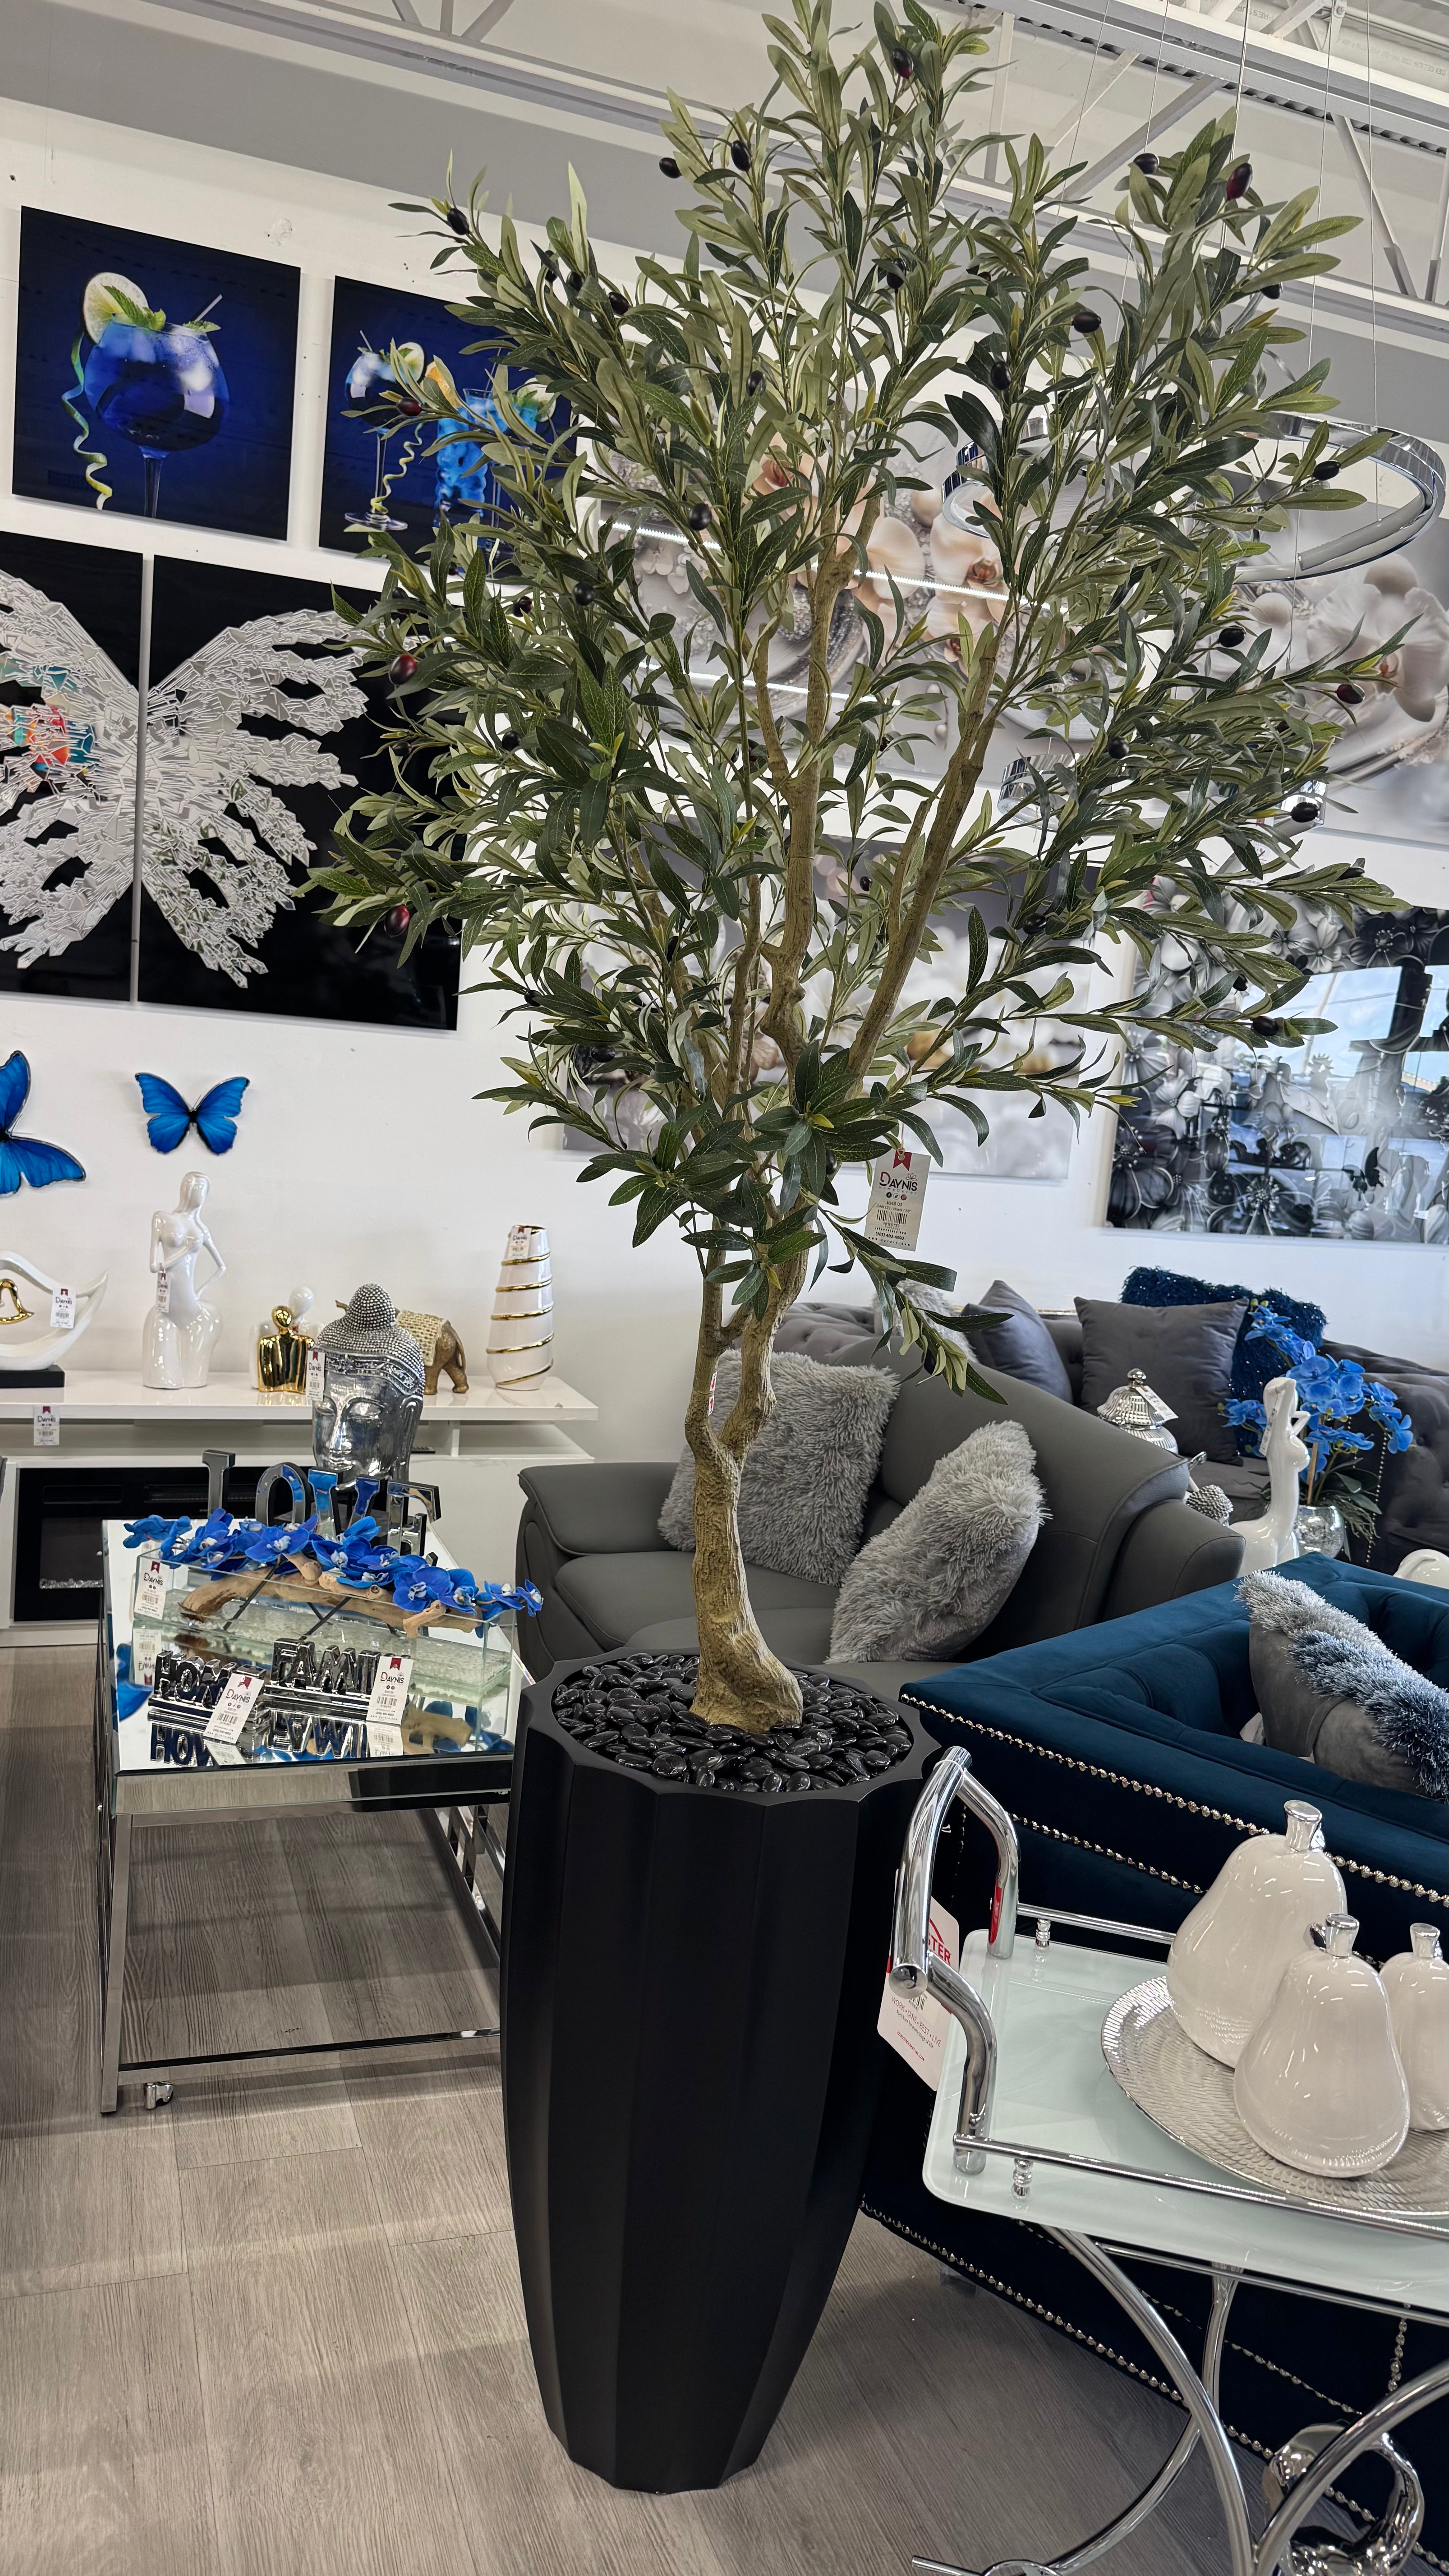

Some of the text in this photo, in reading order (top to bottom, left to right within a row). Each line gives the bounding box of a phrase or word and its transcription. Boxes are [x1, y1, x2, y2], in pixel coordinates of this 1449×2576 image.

[1235, 5, 1274, 21] PRESSUR
[879, 1171, 918, 1191] DAYNIS
[144, 1572, 163, 1586] DAYNIS
[270, 1638, 380, 1696] FAMI
[154, 1650, 265, 1710] HOM
[380, 1671, 405, 1684] DAYNIS
[225, 1688, 251, 1703] DAYNIS
